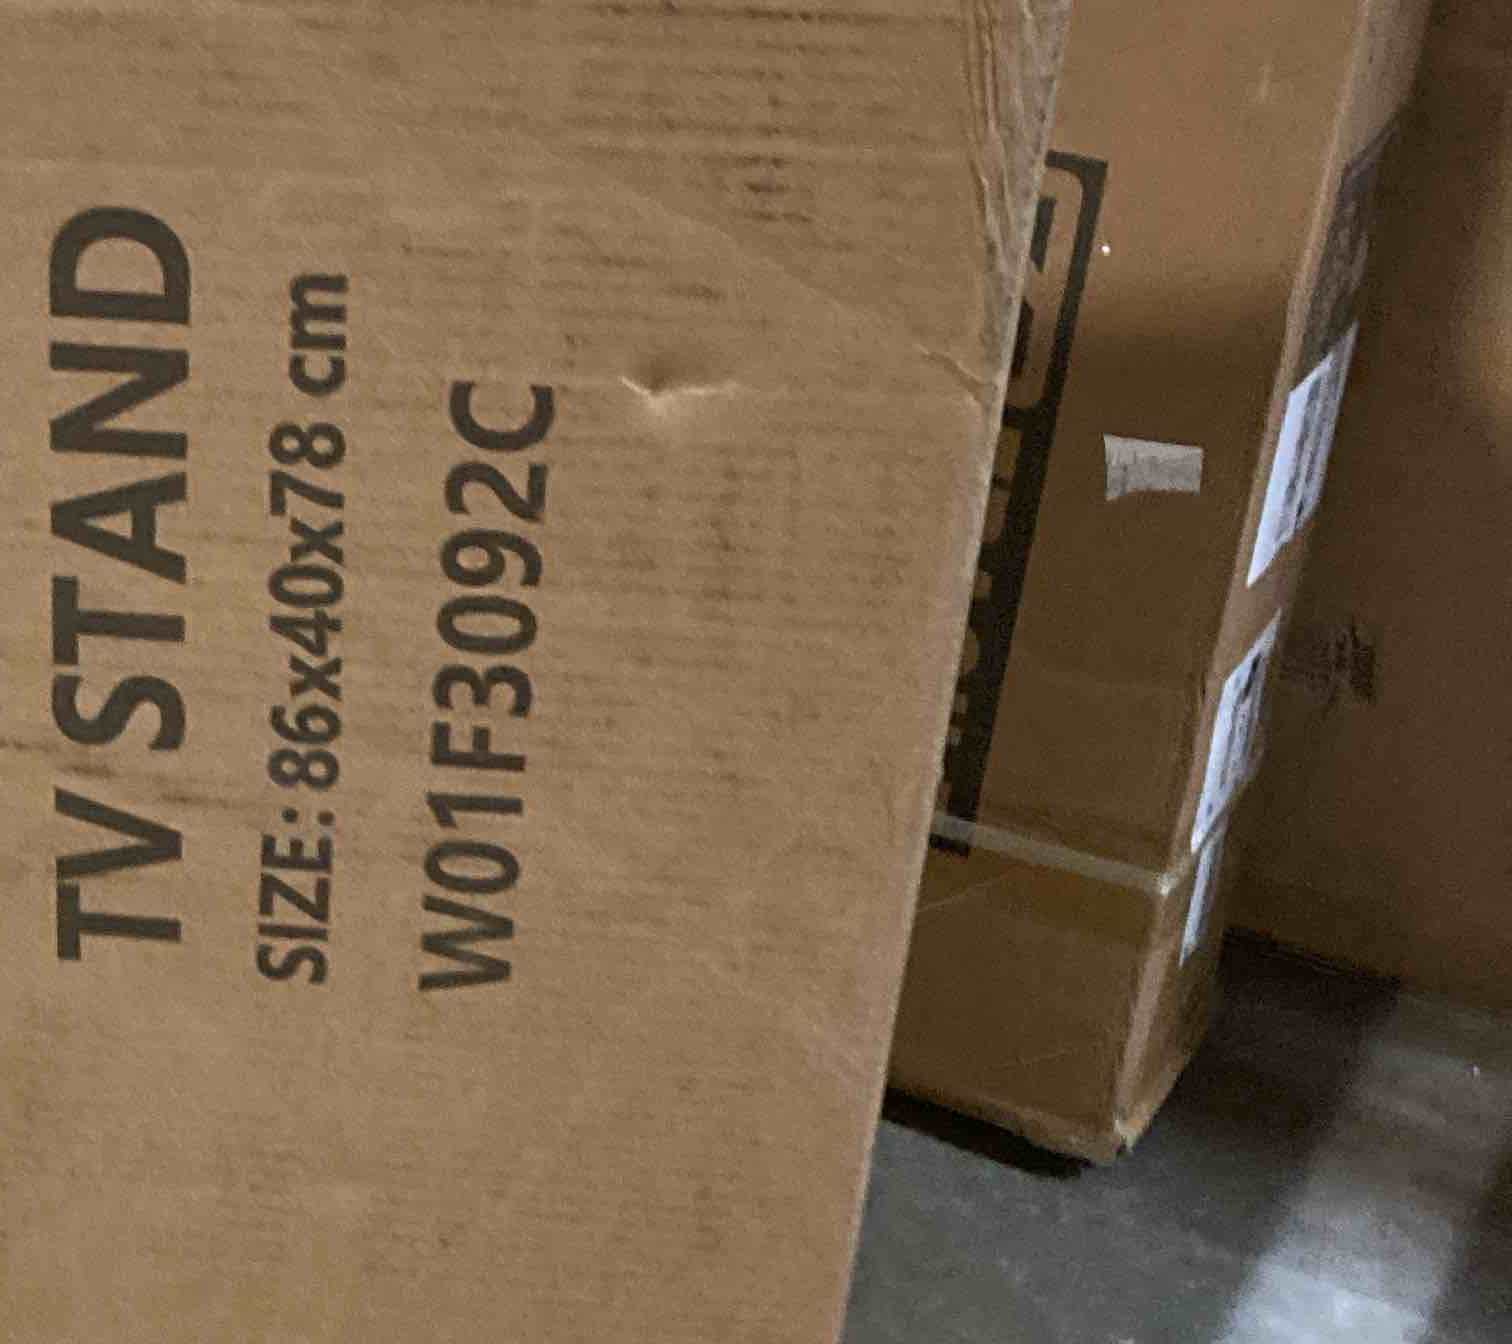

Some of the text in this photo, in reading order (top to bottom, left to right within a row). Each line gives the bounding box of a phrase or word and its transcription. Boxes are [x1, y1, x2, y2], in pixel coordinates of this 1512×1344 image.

[50, 205, 191, 960] TV STAND
[257, 272, 349, 985] SIZE: 86x40x78 cm
[419, 381, 555, 992] W01F3092C
